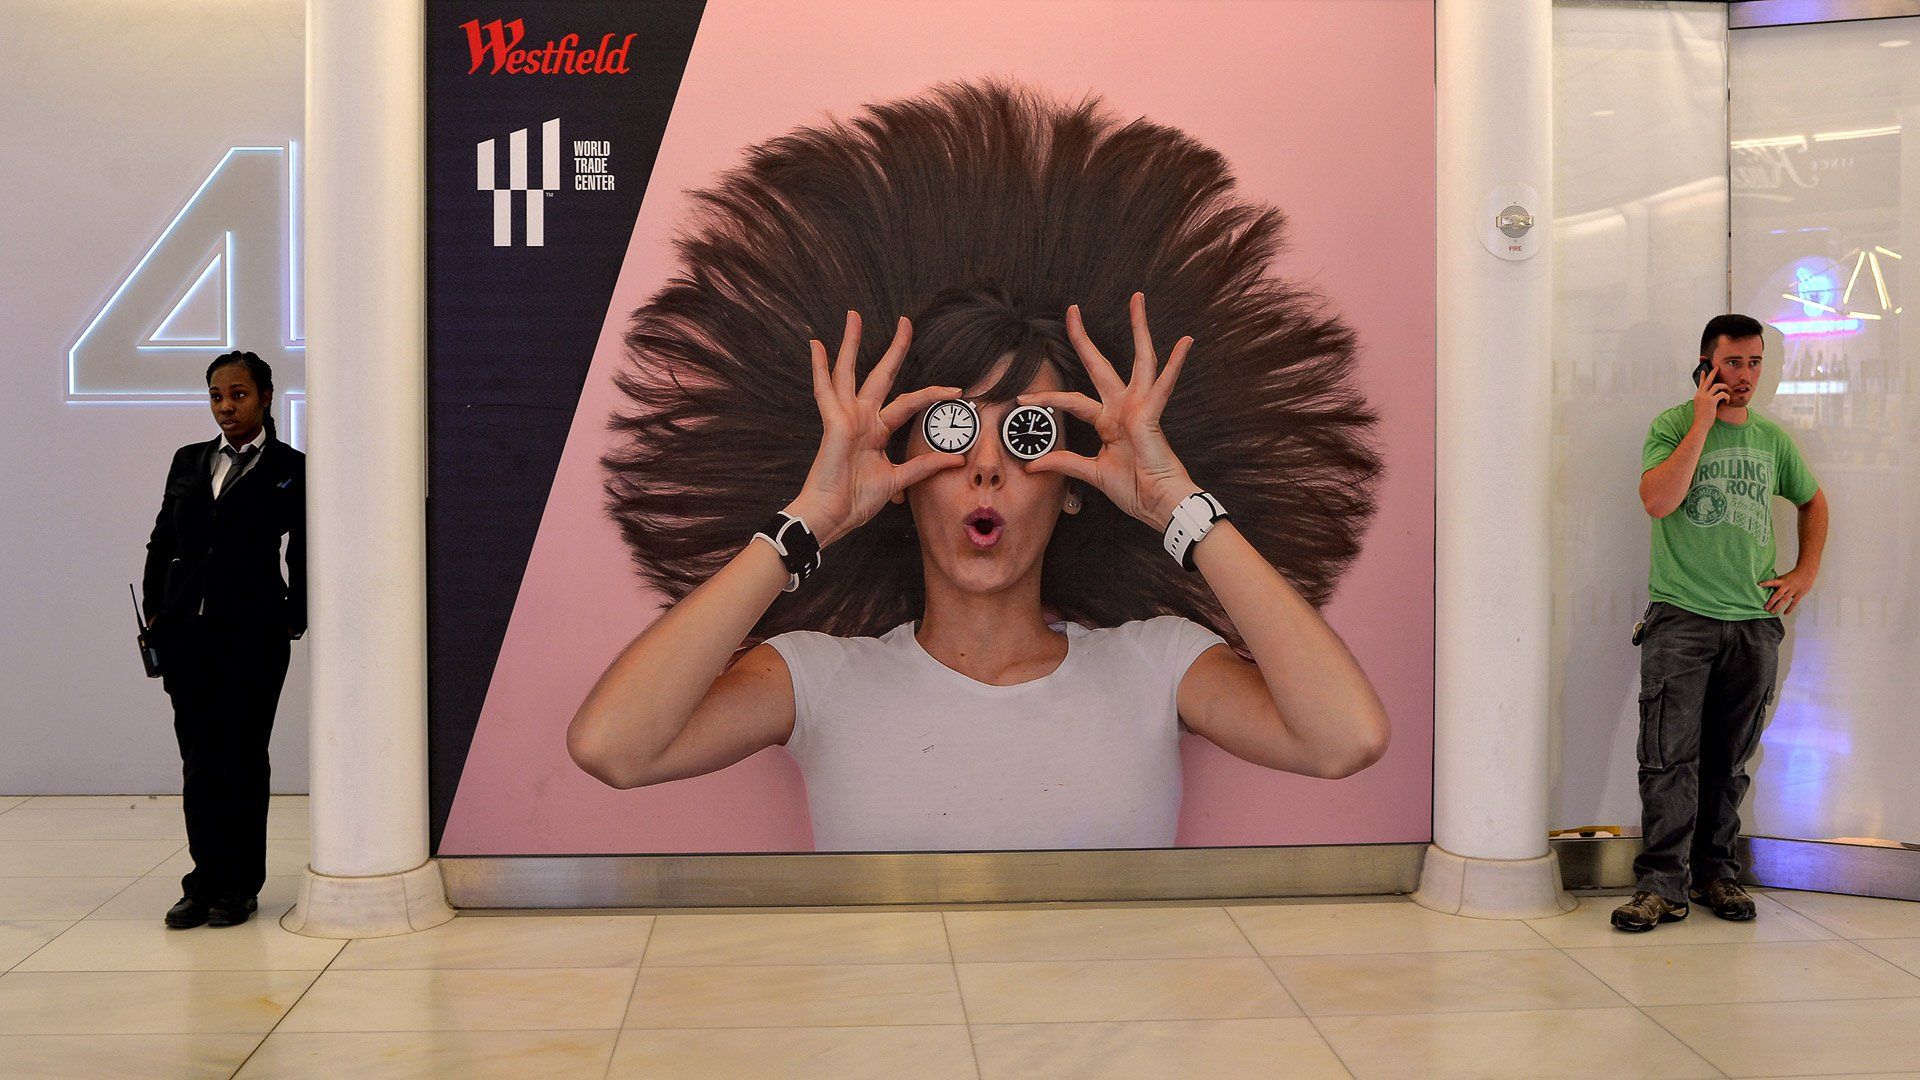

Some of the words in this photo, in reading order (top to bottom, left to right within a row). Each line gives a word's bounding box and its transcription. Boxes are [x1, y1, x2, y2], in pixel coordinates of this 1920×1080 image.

[458, 18, 638, 75] Westfield
[573, 140, 610, 157] WORLD
[574, 158, 607, 173] TRADE
[575, 175, 615, 190] CENTER
[65, 140, 306, 452] 4
[1700, 459, 1767, 484] ROLLING
[1727, 480, 1766, 506] ROCK
